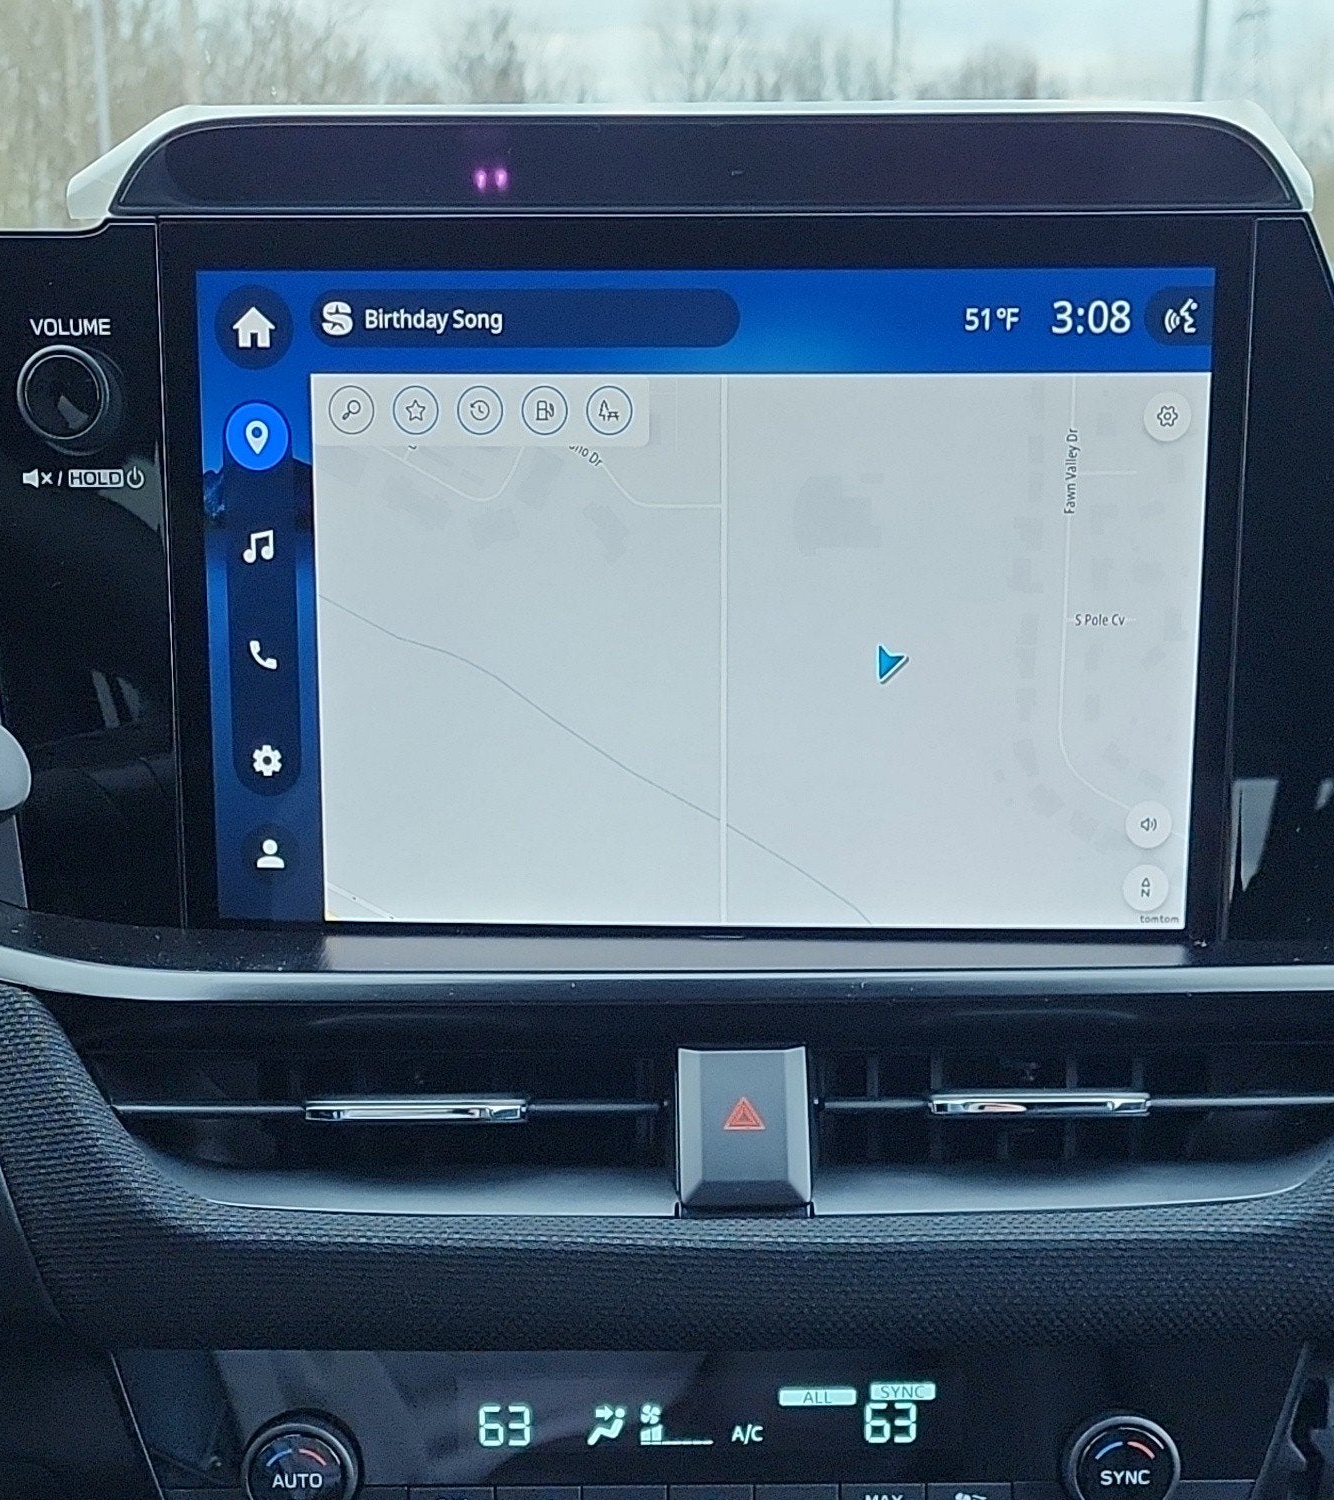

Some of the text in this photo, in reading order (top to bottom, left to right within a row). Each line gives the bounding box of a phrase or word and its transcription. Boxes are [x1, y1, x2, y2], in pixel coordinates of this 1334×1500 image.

[365, 308, 449, 335] Birthday
[452, 309, 503, 335] Song
[1051, 300, 1132, 335] 3:08
[29, 318, 112, 336] VOLUME
[70, 470, 123, 487] HOLD
[1063, 428, 1081, 514] Fawn Valley Dr
[1075, 613, 1125, 627] S Pole Cv
[1140, 888, 1151, 898] N
[1140, 915, 1180, 924] tomtom
[802, 1388, 832, 1405] ALL
[879, 1383, 925, 1400] SYNC
[478, 1404, 532, 1447] 63
[864, 1401, 918, 1444] 63
[731, 1424, 764, 1444] A/C
[272, 1472, 323, 1489] AUTO
[1100, 1469, 1151, 1486] SYNC
